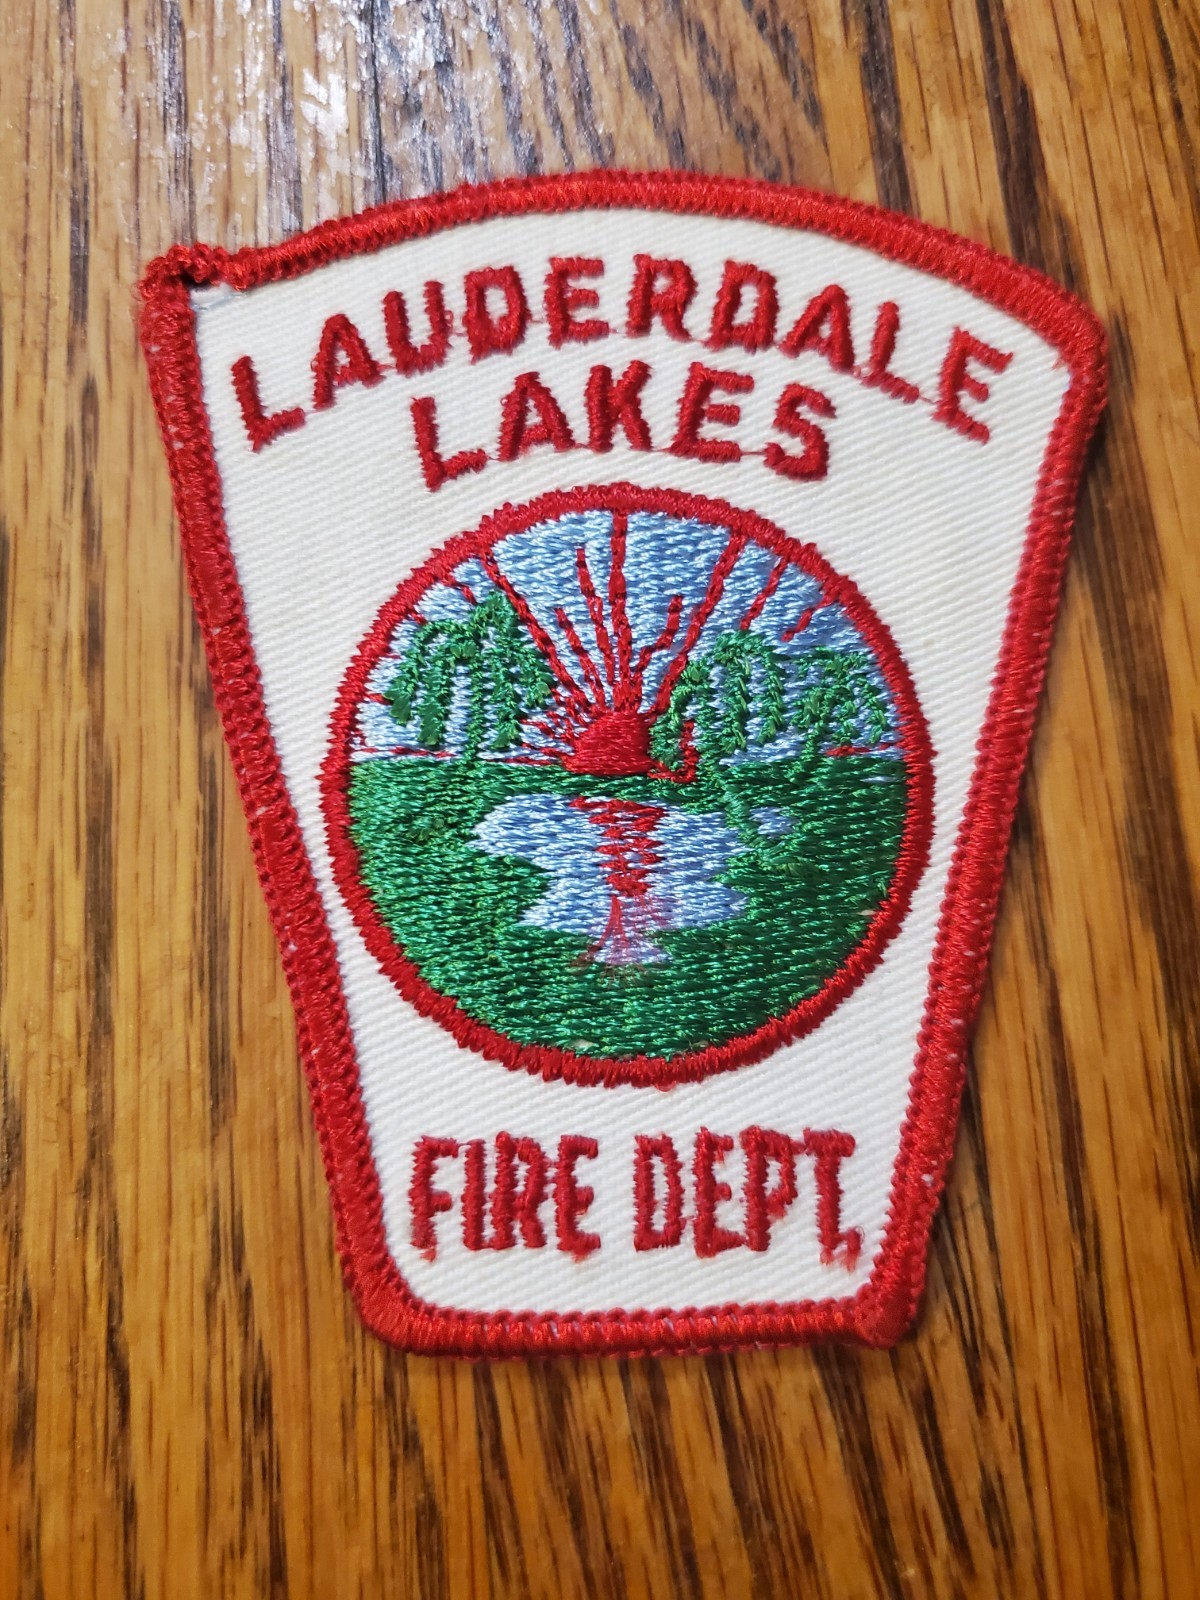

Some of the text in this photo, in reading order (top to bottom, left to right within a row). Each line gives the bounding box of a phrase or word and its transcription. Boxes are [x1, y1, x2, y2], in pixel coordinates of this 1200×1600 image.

[231, 254, 1012, 450] LAUDERDALE
[412, 360, 836, 491] LAKES
[410, 1132, 600, 1263] FIRE
